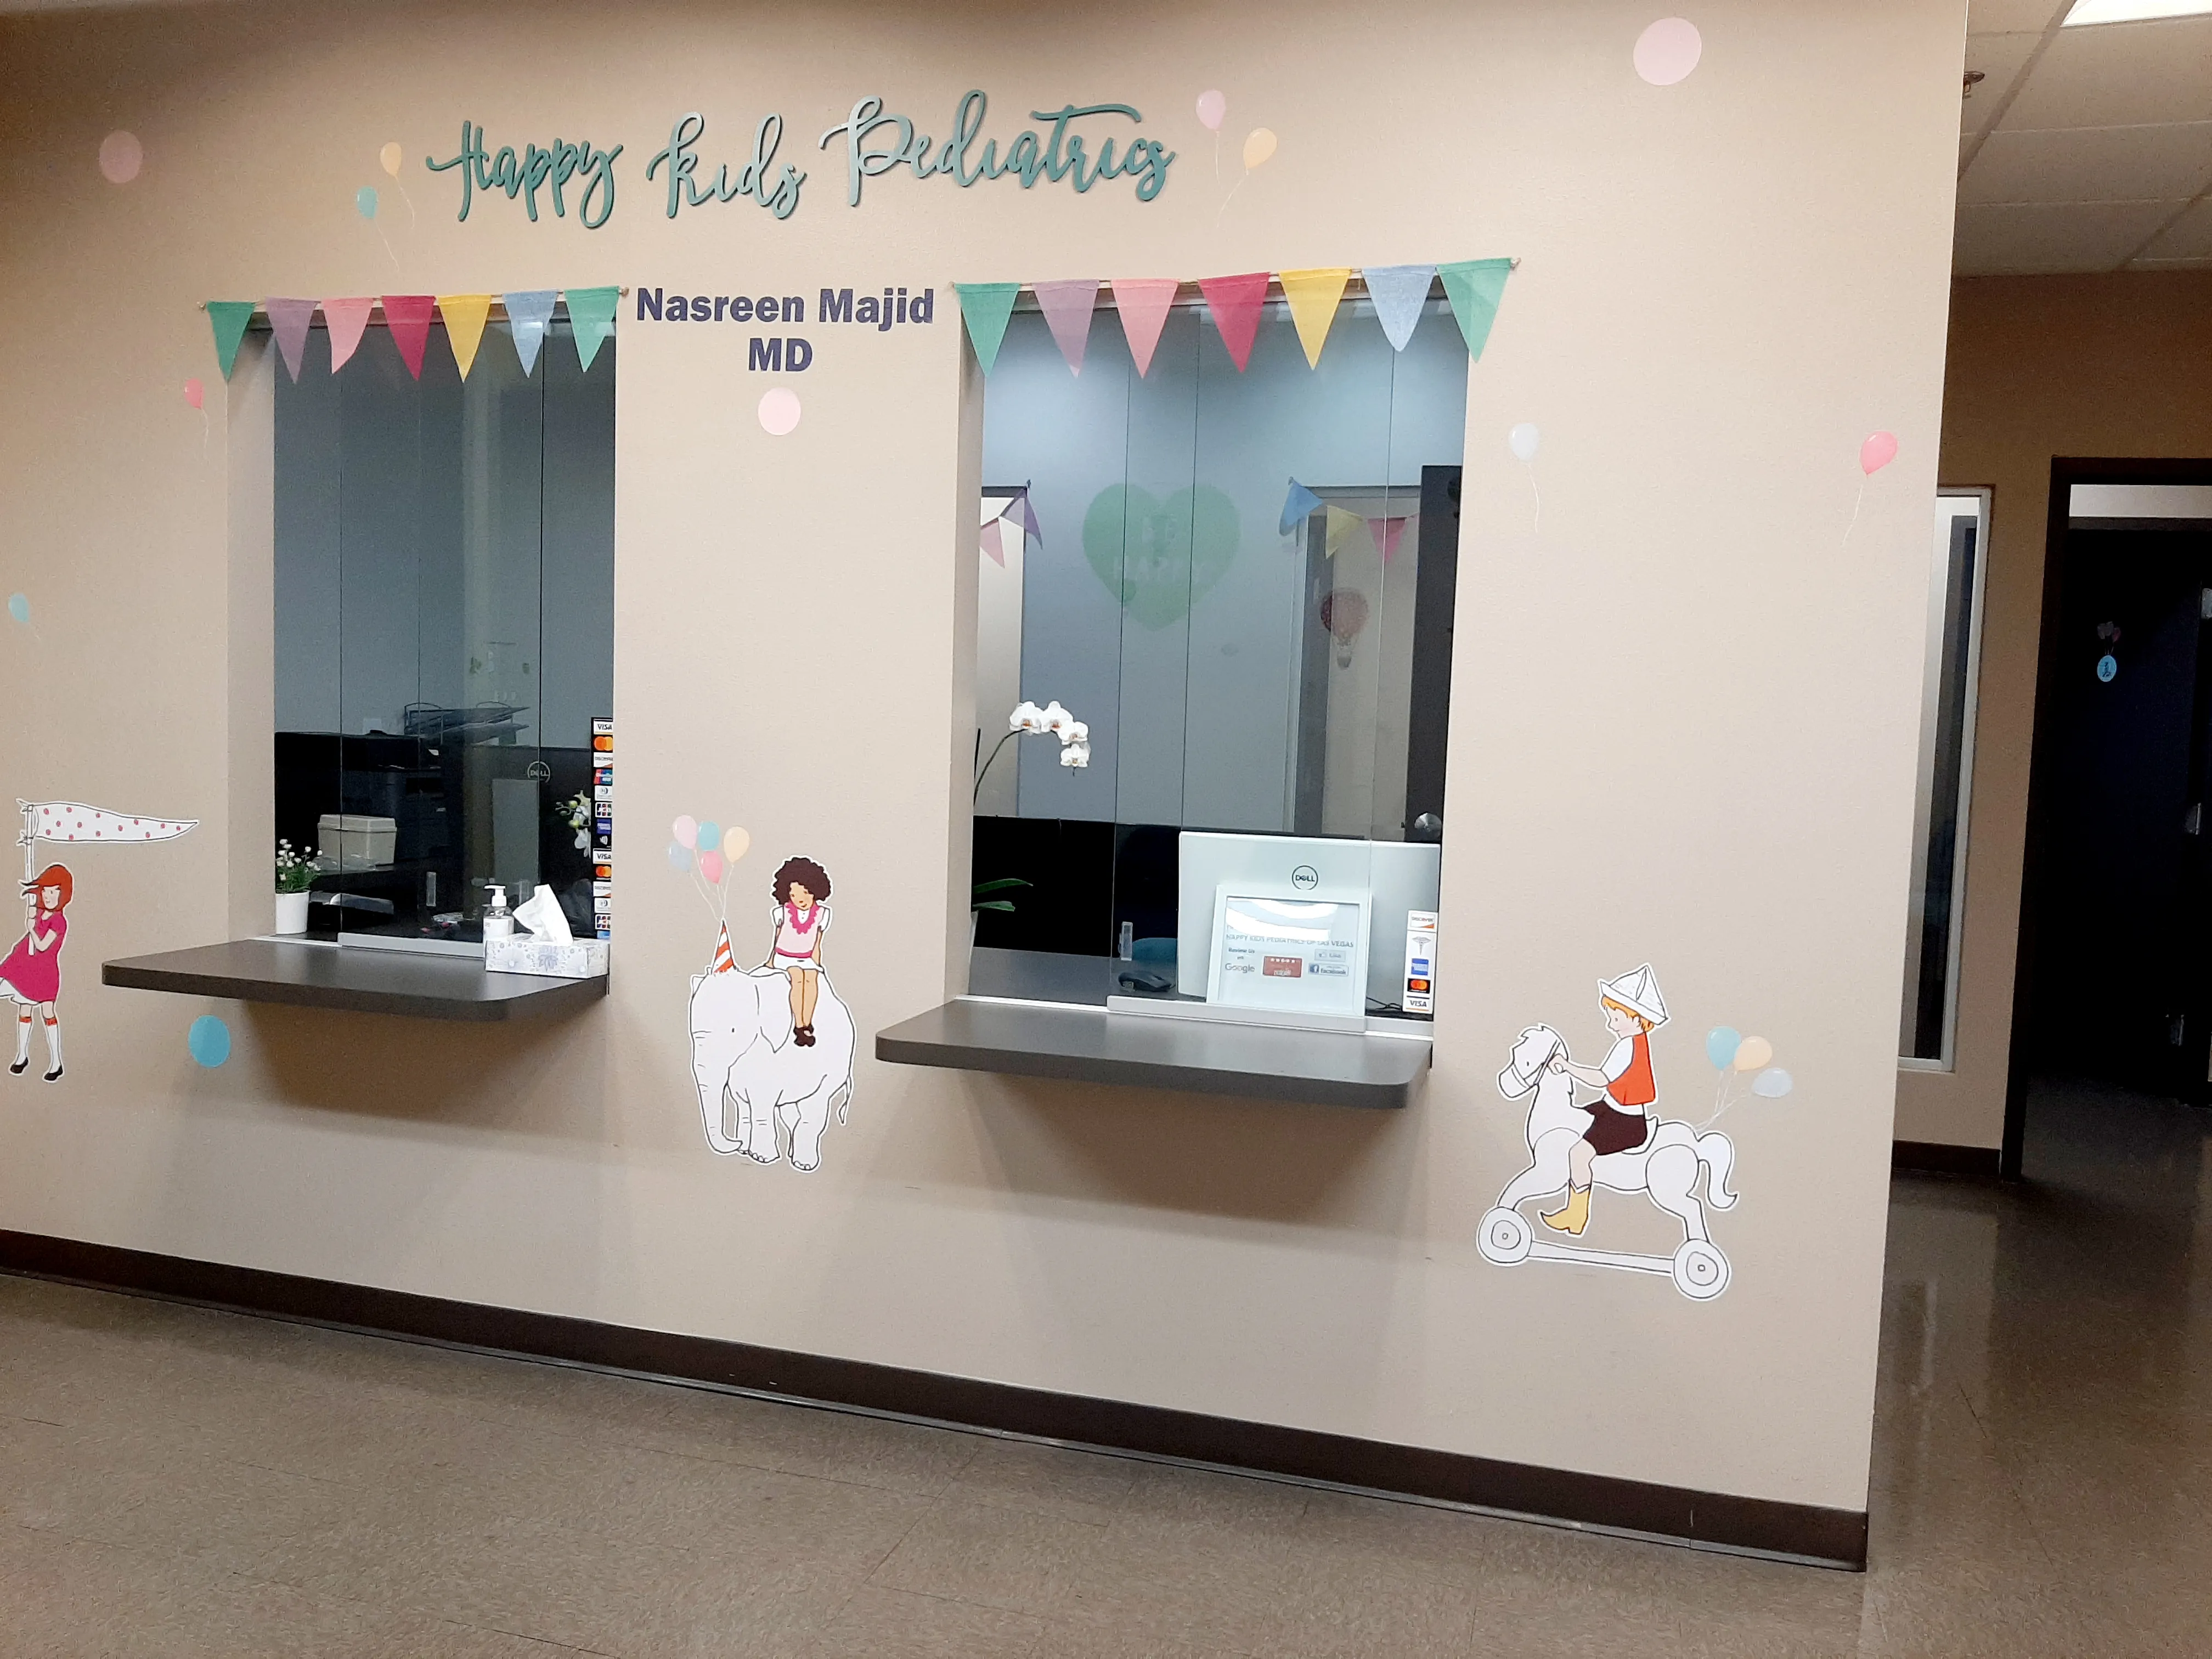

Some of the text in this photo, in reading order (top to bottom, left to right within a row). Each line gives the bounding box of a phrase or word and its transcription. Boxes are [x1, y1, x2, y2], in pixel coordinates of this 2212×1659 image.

[426, 120, 623, 229] Happy
[818, 89, 1177, 207] Pediatrics
[637, 287, 934, 331] Nasreen Majid
[748, 337, 813, 372] MD
[1225, 963, 1255, 974] Google
